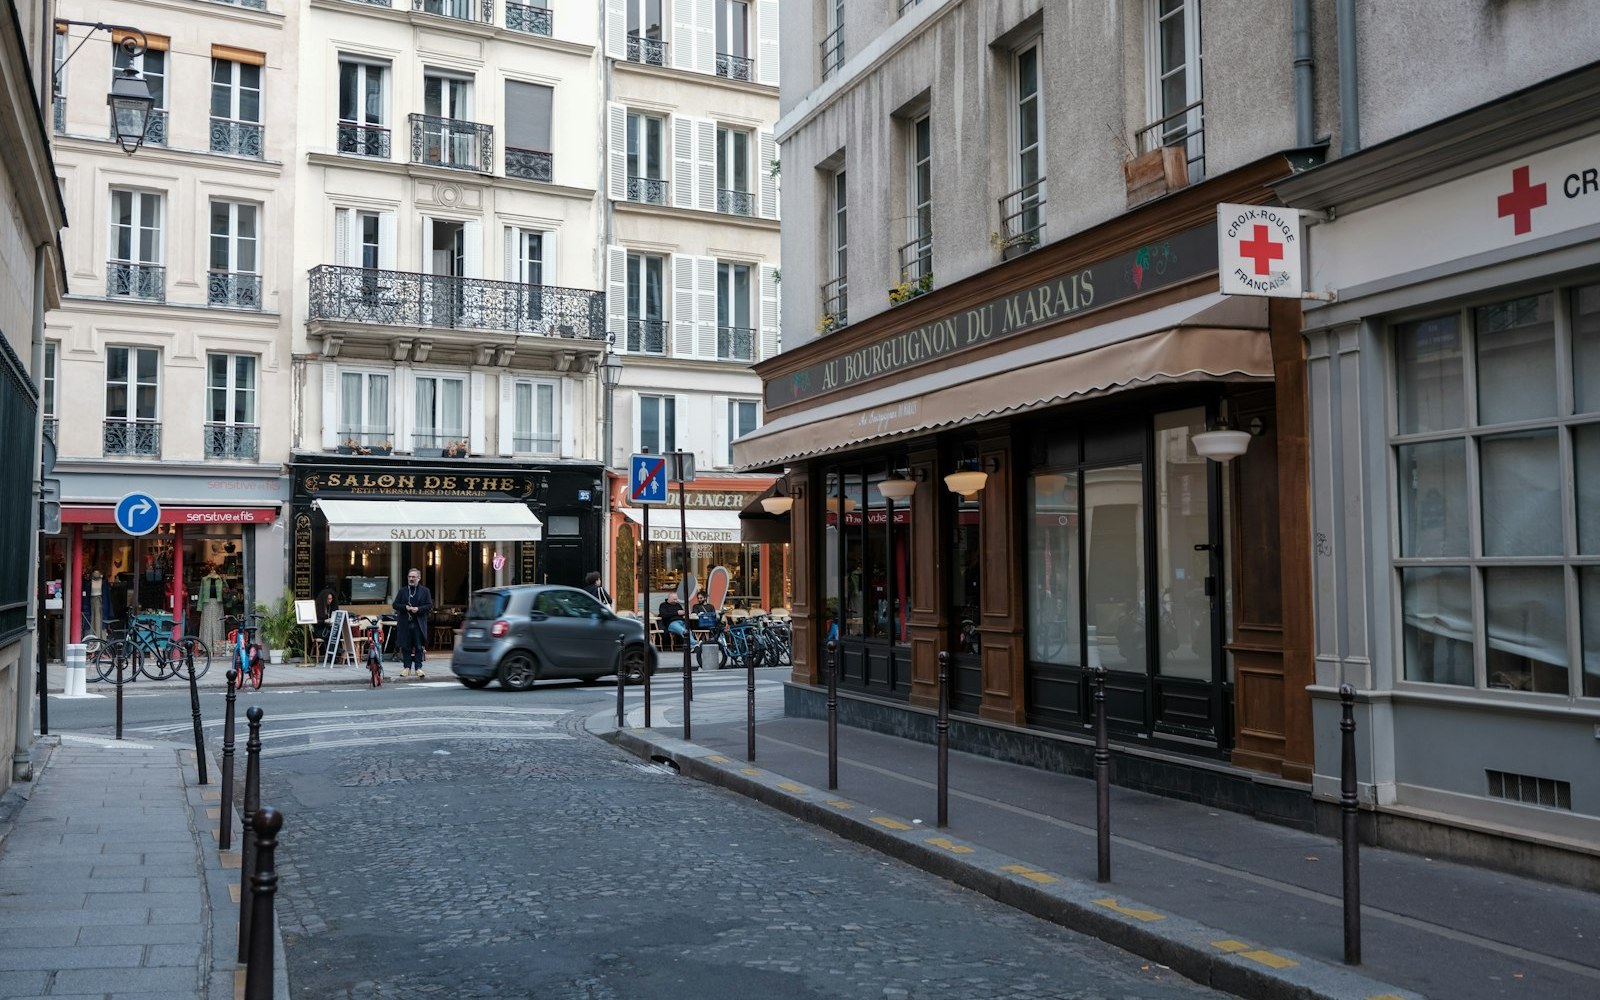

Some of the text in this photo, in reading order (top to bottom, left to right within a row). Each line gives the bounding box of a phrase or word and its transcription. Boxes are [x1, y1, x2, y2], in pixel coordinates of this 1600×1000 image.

[1564, 168, 1599, 199] CR
[1228, 209, 1295, 243] CROIX-ROUGE
[1234, 268, 1290, 293] FRANÇAISE
[822, 269, 1095, 390] AU BOURGUIGNON DU MARAIS
[328, 473, 514, 491] SALON DE THE
[380, 488, 435, 496] VERSAILLES
[451, 489, 487, 497] MARAIS
[581, 491, 590, 500] 25
[666, 493, 744, 507] OULANGER
[186, 511, 233, 522] sensitive
[240, 511, 254, 521] fils
[390, 526, 487, 540] SALON DE THÉ
[653, 529, 732, 541] BOULANGERIE
